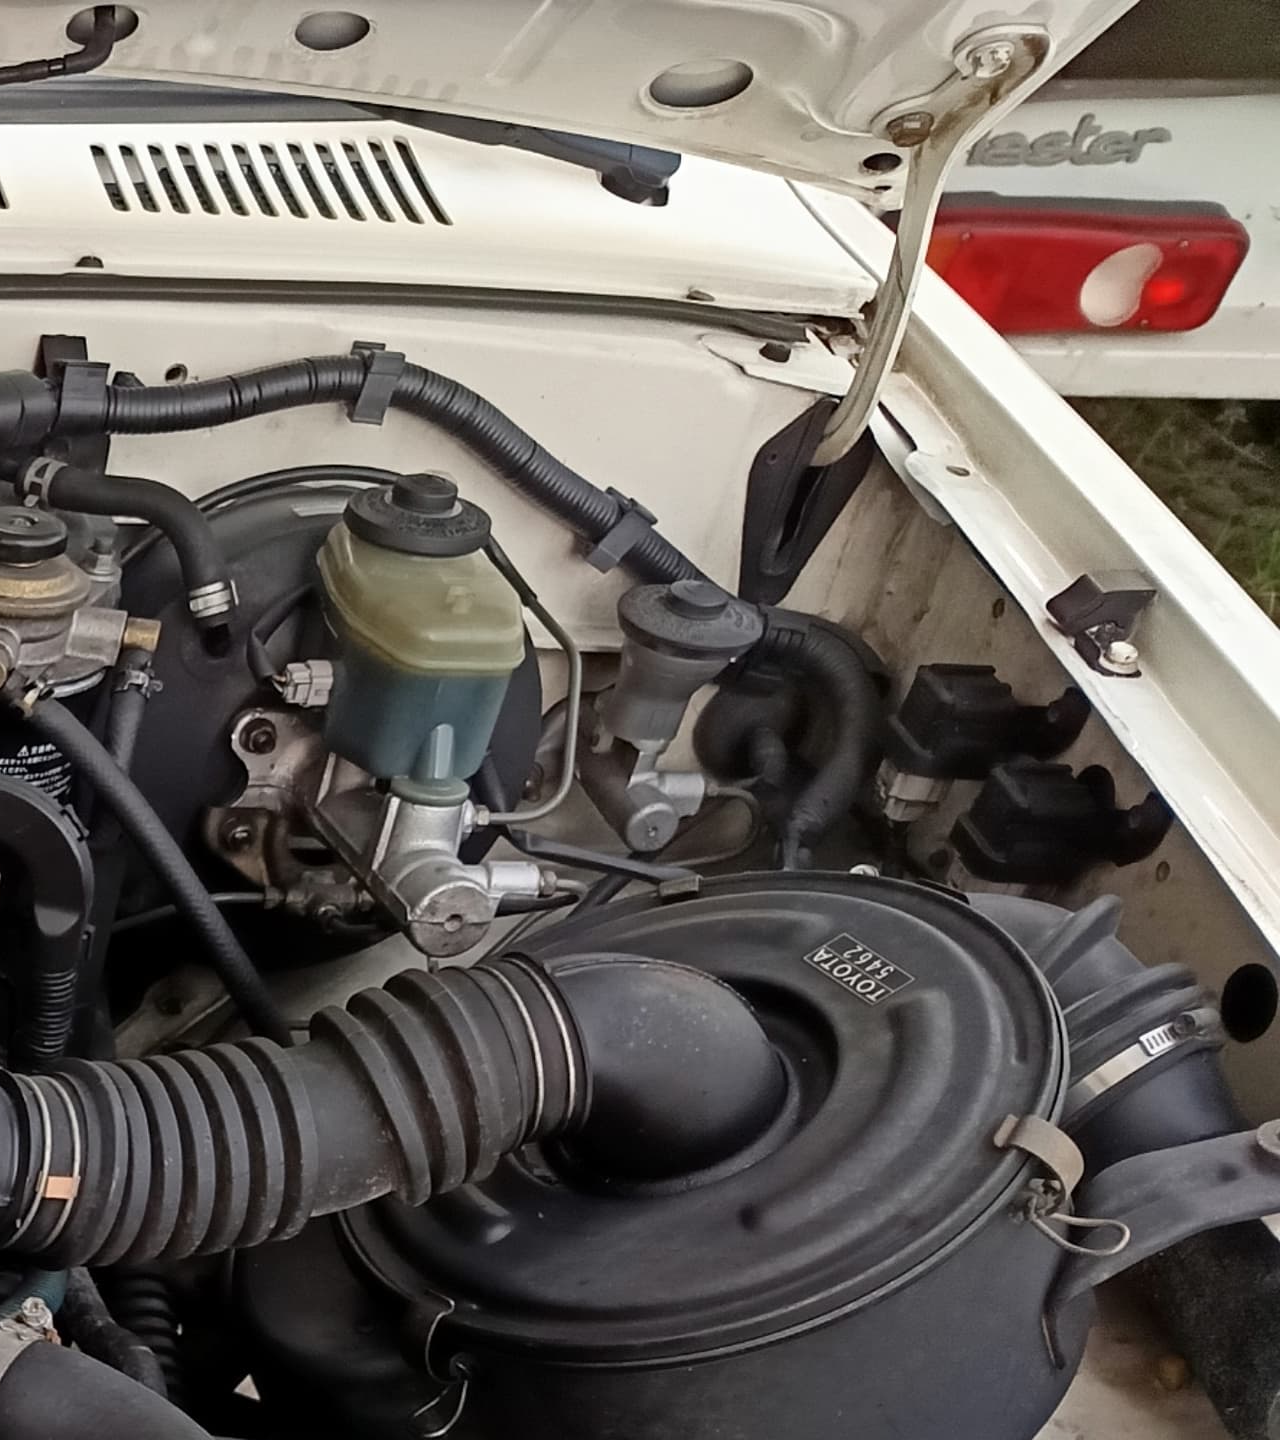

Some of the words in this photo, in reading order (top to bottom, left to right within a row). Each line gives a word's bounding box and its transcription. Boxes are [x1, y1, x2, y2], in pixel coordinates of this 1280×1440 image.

[966, 112, 1172, 167] aster
[812, 947, 886, 1001] TOYOTA
[842, 944, 894, 979] 5462
